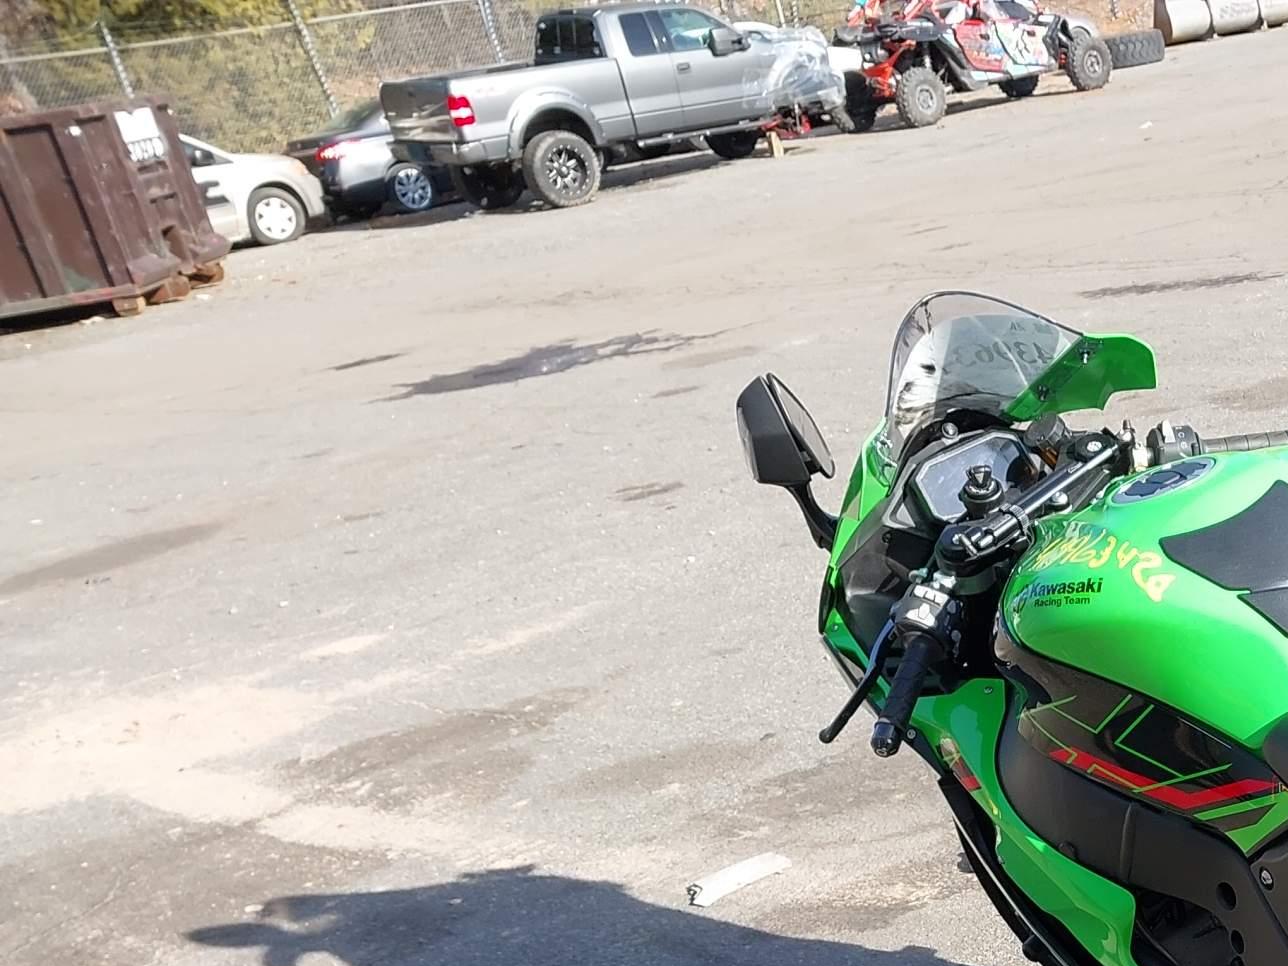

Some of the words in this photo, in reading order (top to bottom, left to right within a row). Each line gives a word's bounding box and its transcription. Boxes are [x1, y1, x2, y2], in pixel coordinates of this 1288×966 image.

[1030, 577, 1104, 599] Kawasaki
[1034, 596, 1062, 608] Racing
[1064, 594, 1091, 606] Team
